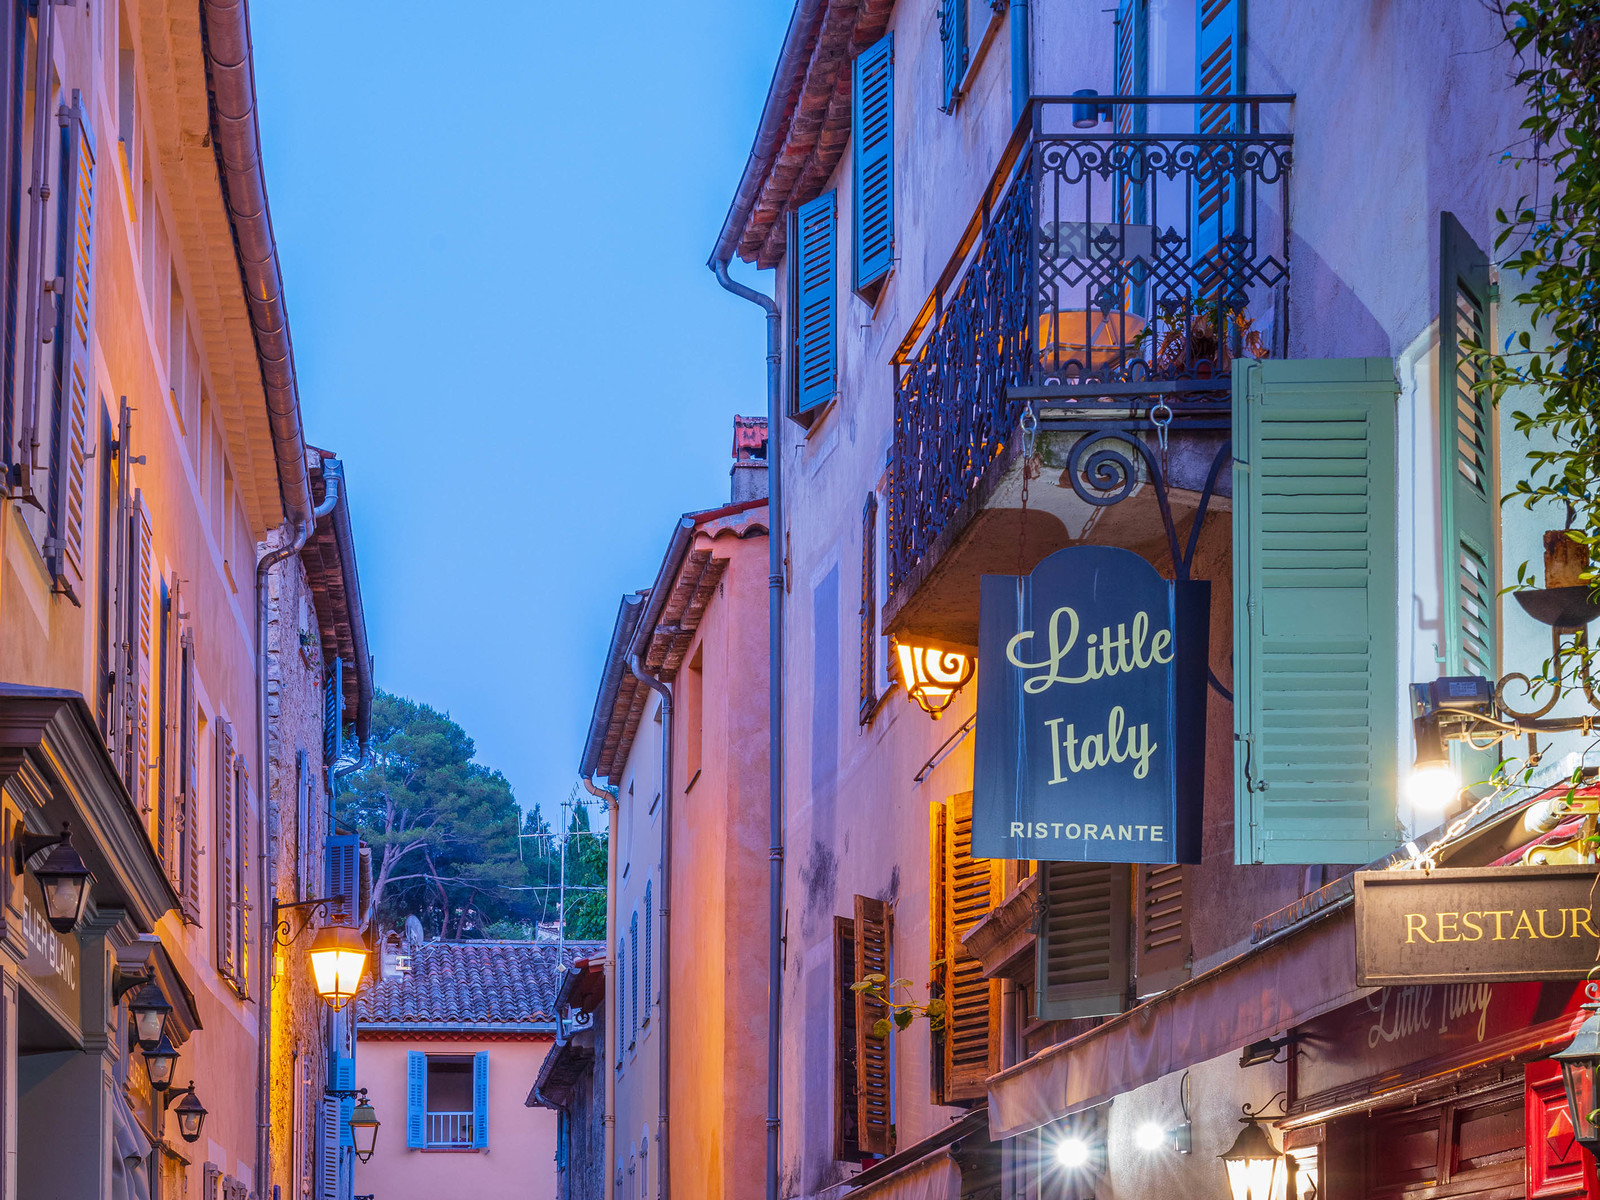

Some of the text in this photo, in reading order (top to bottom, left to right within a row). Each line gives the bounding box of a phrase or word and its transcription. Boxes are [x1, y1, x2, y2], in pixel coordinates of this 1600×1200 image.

[1006, 606, 1175, 694] Little
[1044, 705, 1158, 785] Italy
[1010, 821, 1164, 842] RISTORANTE
[1404, 907, 1600, 944] RESTAUR
[49, 928, 75, 991] BLANC
